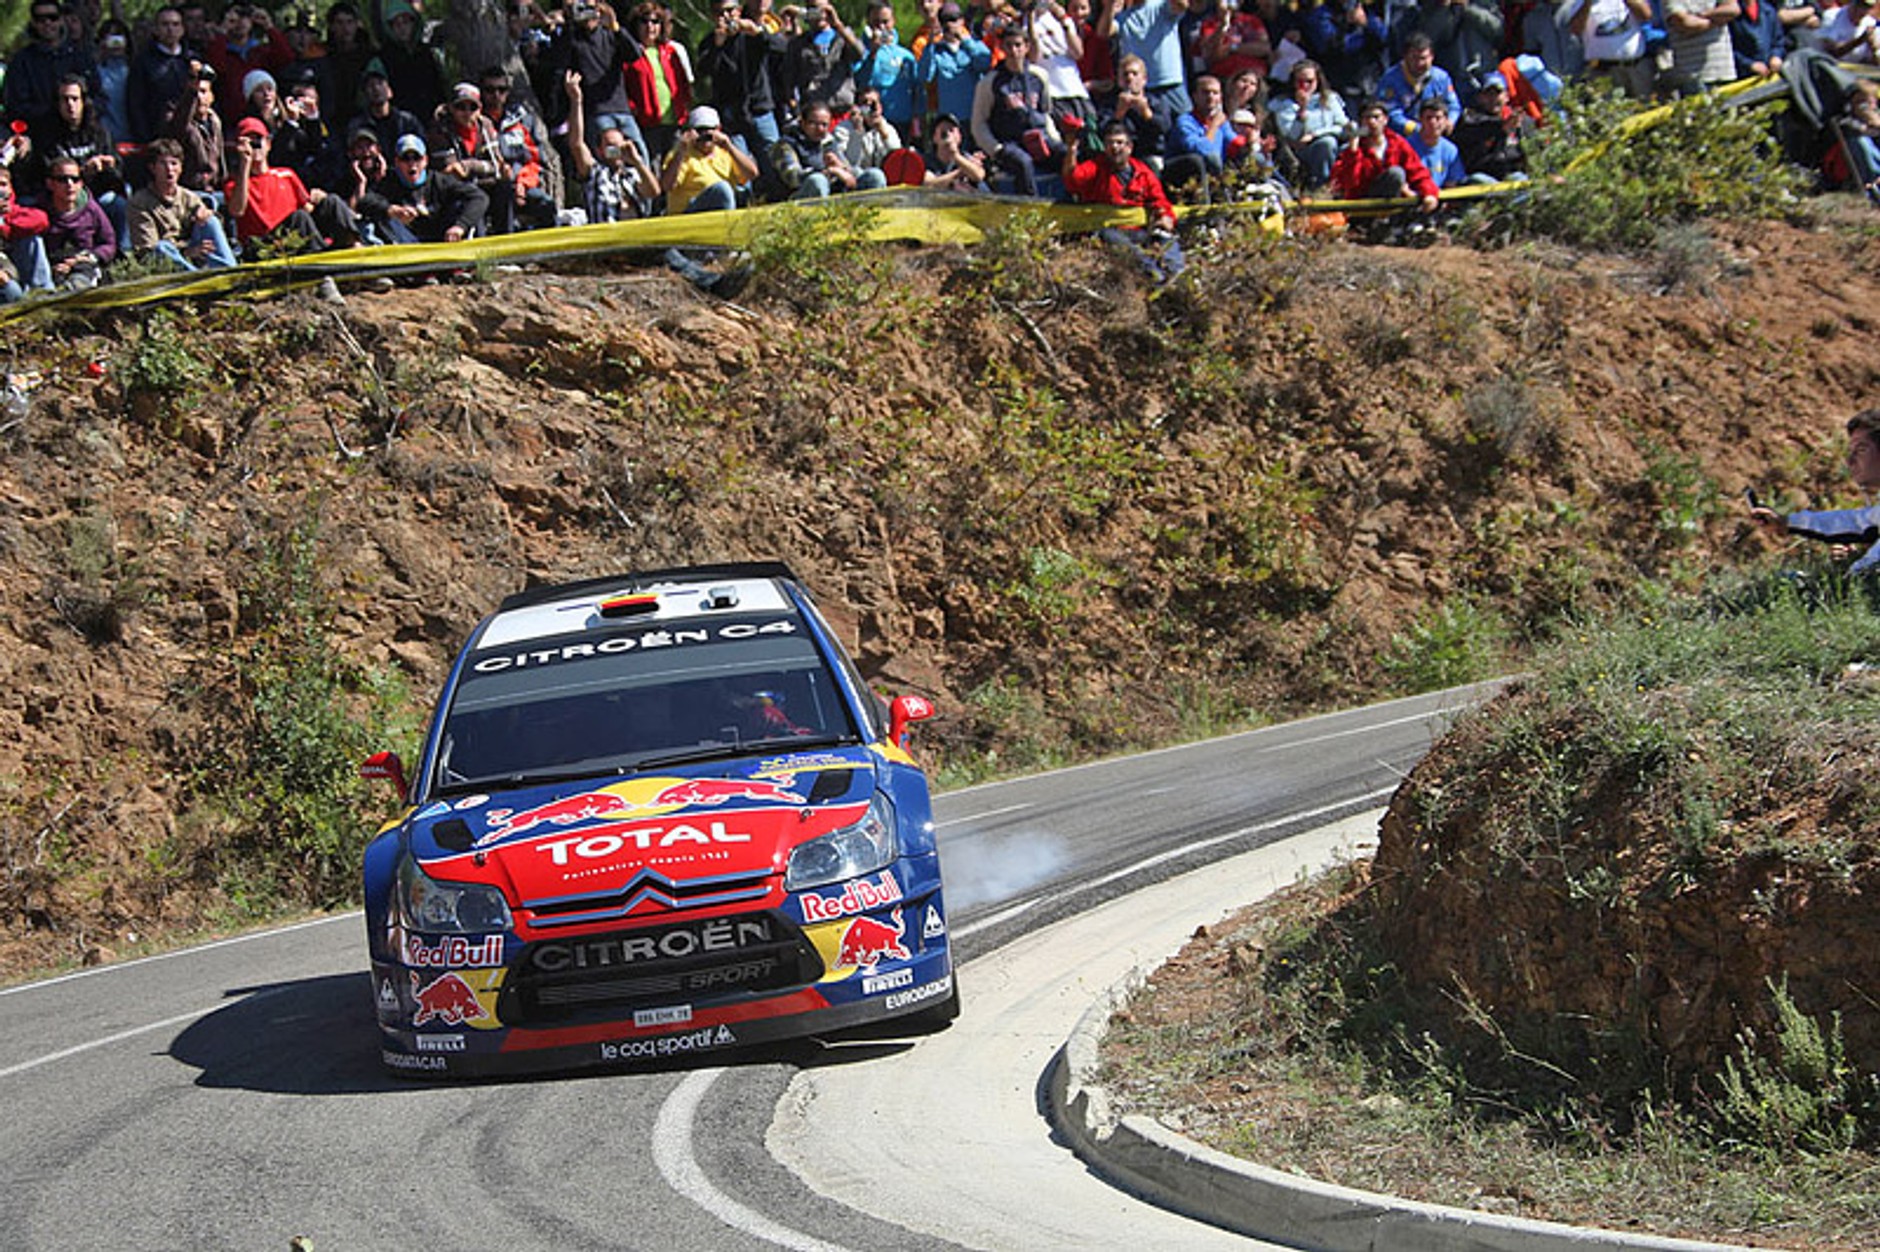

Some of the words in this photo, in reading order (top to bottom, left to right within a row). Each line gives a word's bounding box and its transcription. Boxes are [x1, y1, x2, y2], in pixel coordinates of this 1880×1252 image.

[474, 627, 709, 672] CITROËN
[718, 620, 797, 639] C4
[535, 822, 751, 866] TOTAL
[800, 881, 862, 922] Red
[857, 869, 903, 909] Bull
[406, 935, 449, 966] Red
[448, 935, 503, 966] Bull
[532, 919, 772, 971] CITROËN
[688, 957, 778, 990] SPORT
[601, 1042, 618, 1059] le
[620, 1040, 657, 1057] coq
[657, 1028, 712, 1055] sportif
